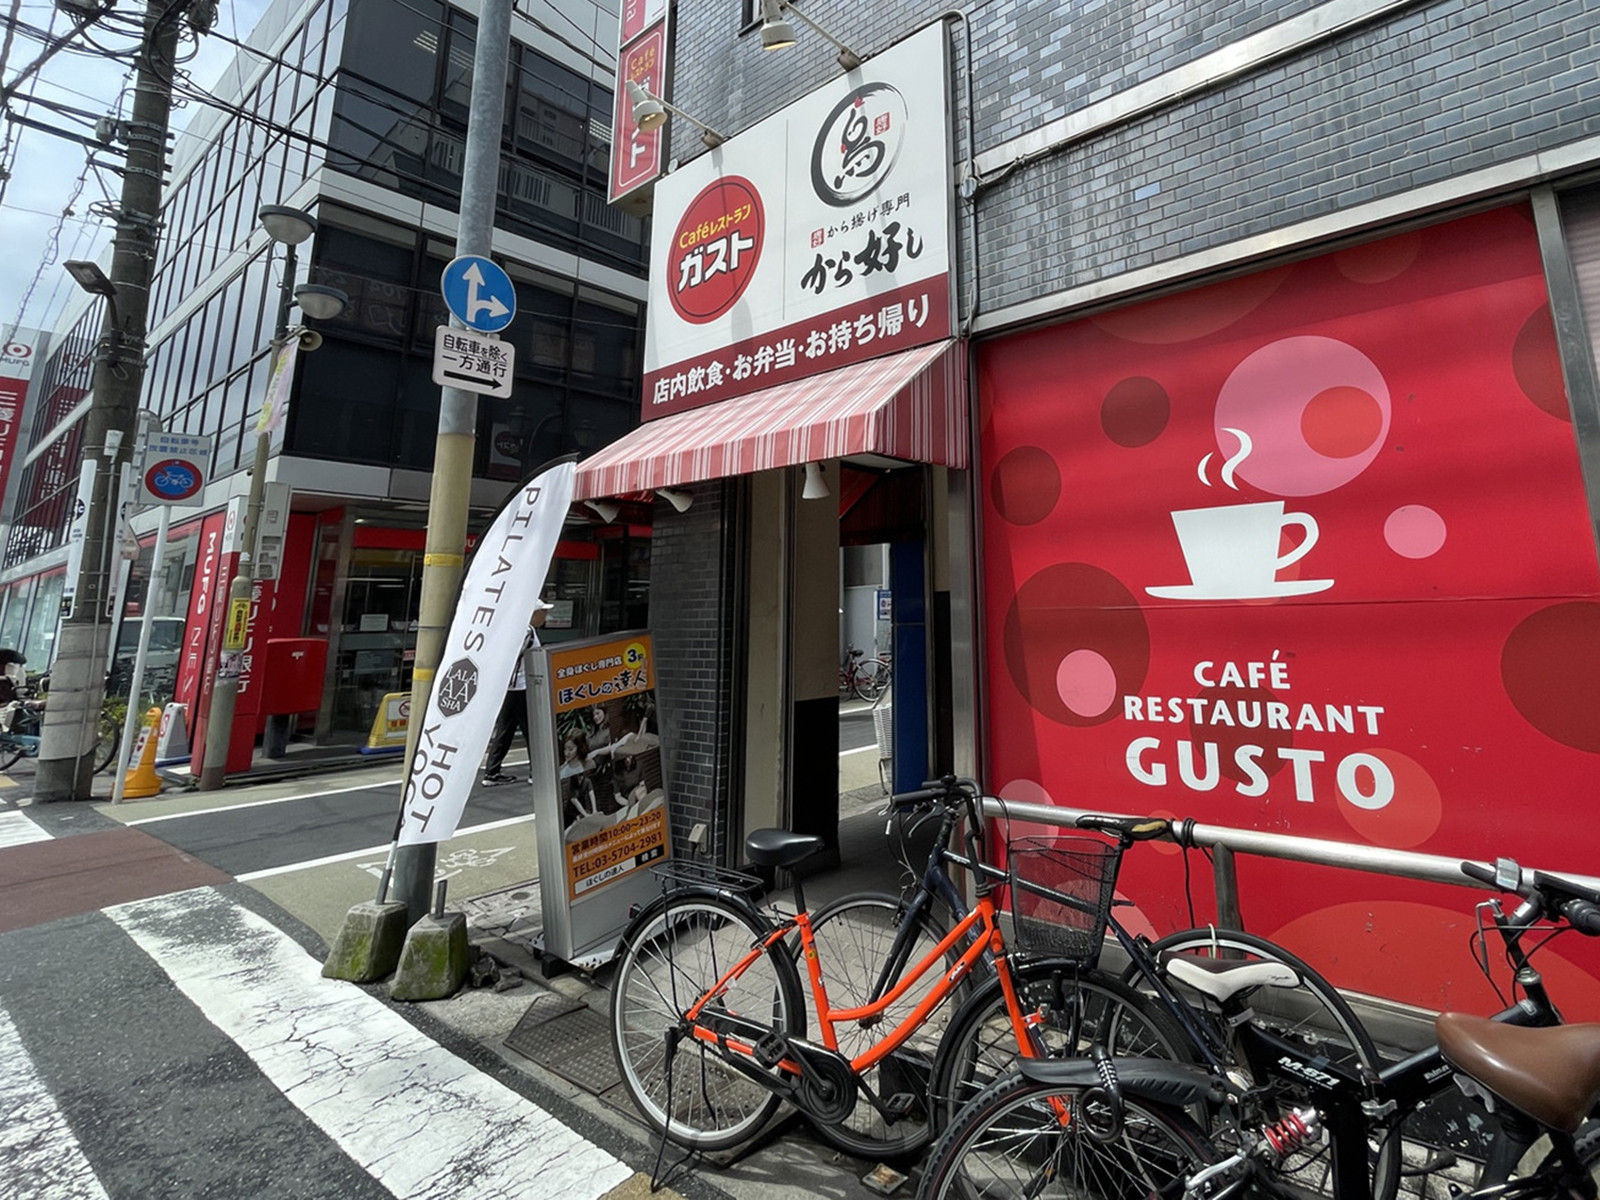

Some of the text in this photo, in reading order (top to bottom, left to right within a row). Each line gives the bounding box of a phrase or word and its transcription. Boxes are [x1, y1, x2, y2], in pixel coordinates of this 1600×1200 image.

[827, 192, 910, 239] から揚げ専門
[677, 230, 754, 293] ガスト
[801, 221, 923, 295] から好し
[442, 355, 508, 378] 一方通行
[444, 334, 508, 362] 自転車を除く
[197, 532, 216, 614] MUFG
[463, 487, 541, 653] PILATES
[446, 666, 478, 686] LALA
[556, 656, 622, 679] 全身ほぐし専門店
[627, 649, 644, 663] 3F
[1193, 649, 1290, 689] CAFÉ
[439, 680, 469, 703] AA
[440, 697, 461, 712] SHA
[558, 670, 646, 704] ほぐしの達人
[1123, 695, 1384, 735] RESTAURANT
[400, 723, 441, 830] YO
[411, 743, 458, 833] HOT
[1125, 736, 1395, 811] GUSTO
[573, 831, 662, 877] TEL:03-5704-2981
